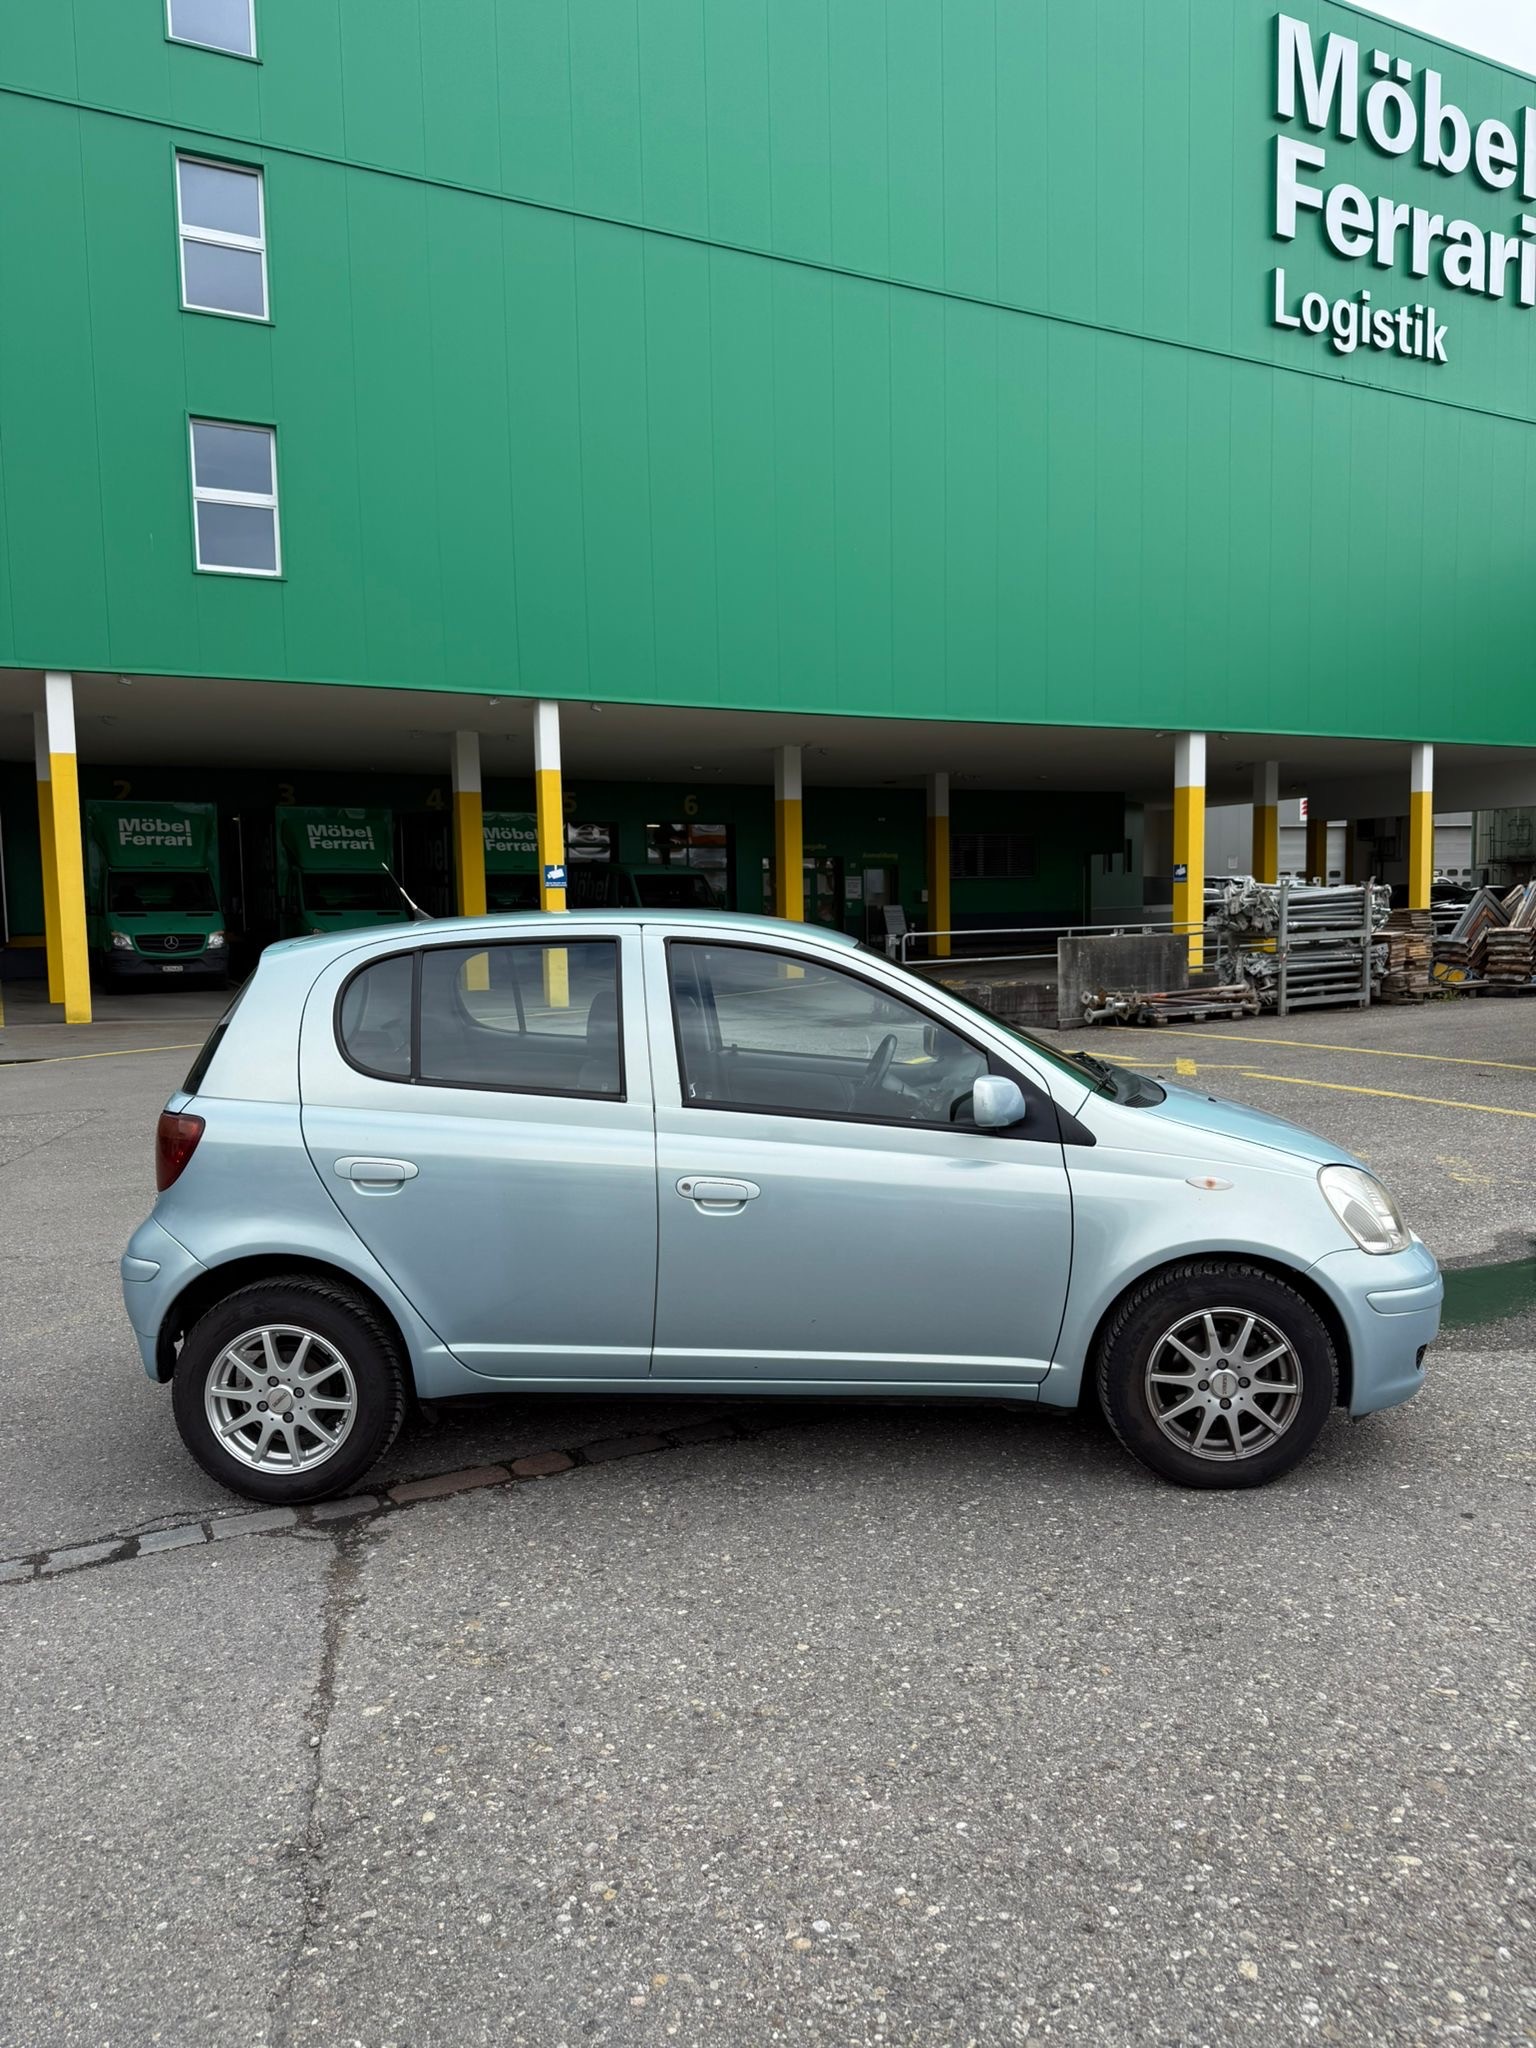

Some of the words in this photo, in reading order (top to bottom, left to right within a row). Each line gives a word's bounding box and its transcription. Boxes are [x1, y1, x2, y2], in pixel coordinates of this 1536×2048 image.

[1274, 12, 1536, 201] Möbel
[1273, 133, 1536, 308] Ferrari
[1273, 266, 1449, 364] Logistik
[277, 783, 296, 804] 3
[426, 787, 446, 810] 4
[683, 794, 699, 815] 6
[118, 817, 191, 834] Möbel
[306, 824, 373, 839] Möbel
[119, 831, 193, 847] Ferrari
[308, 836, 375, 851] Ferrari
[485, 839, 538, 852] Ferrar
